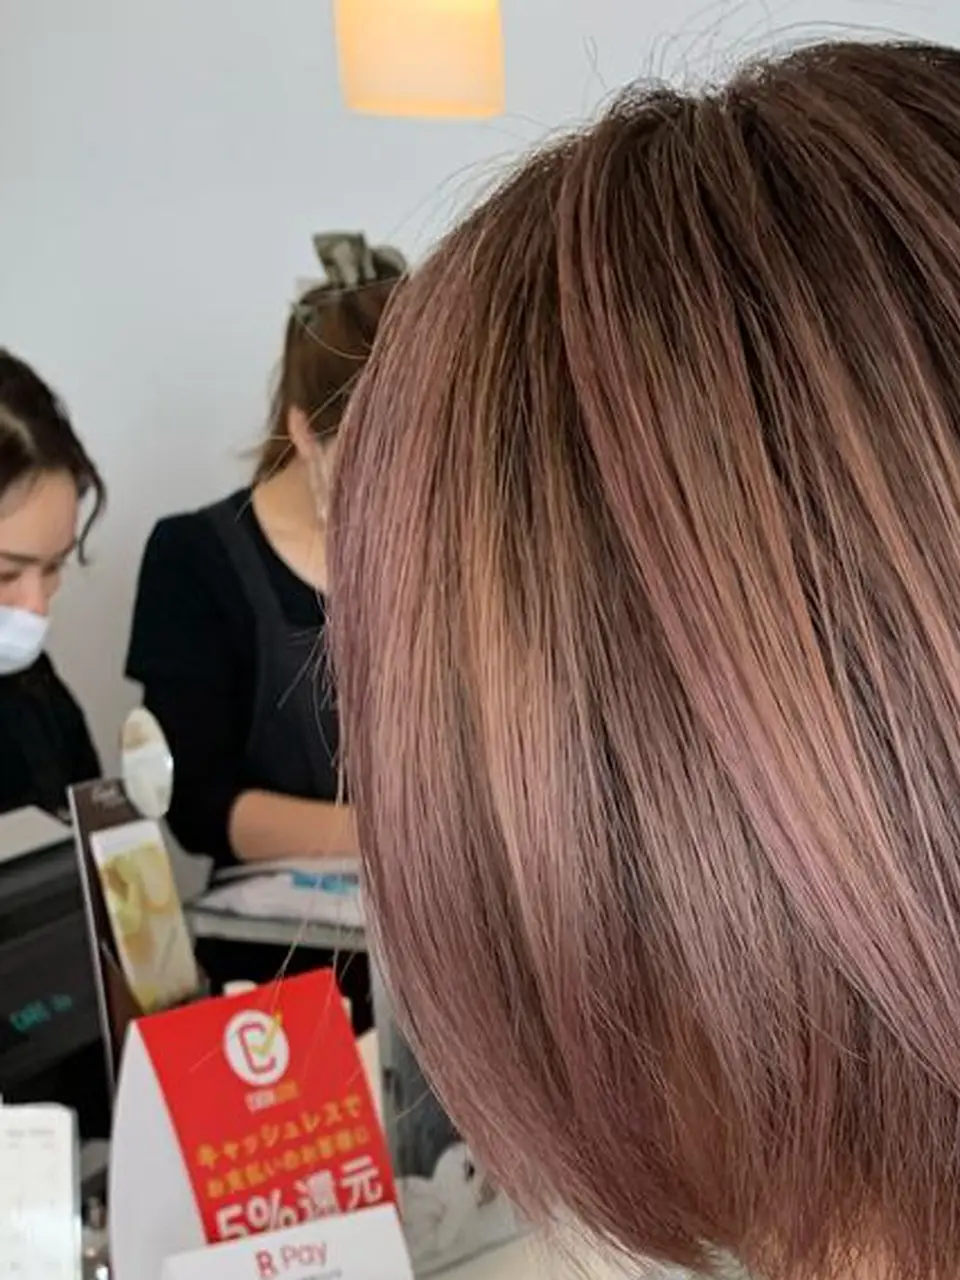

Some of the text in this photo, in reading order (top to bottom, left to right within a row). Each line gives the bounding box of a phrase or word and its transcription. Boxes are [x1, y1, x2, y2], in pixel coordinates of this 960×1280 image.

[197, 1093, 361, 1170] キャッシュレスで
[280, 1242, 328, 1270] Pay
